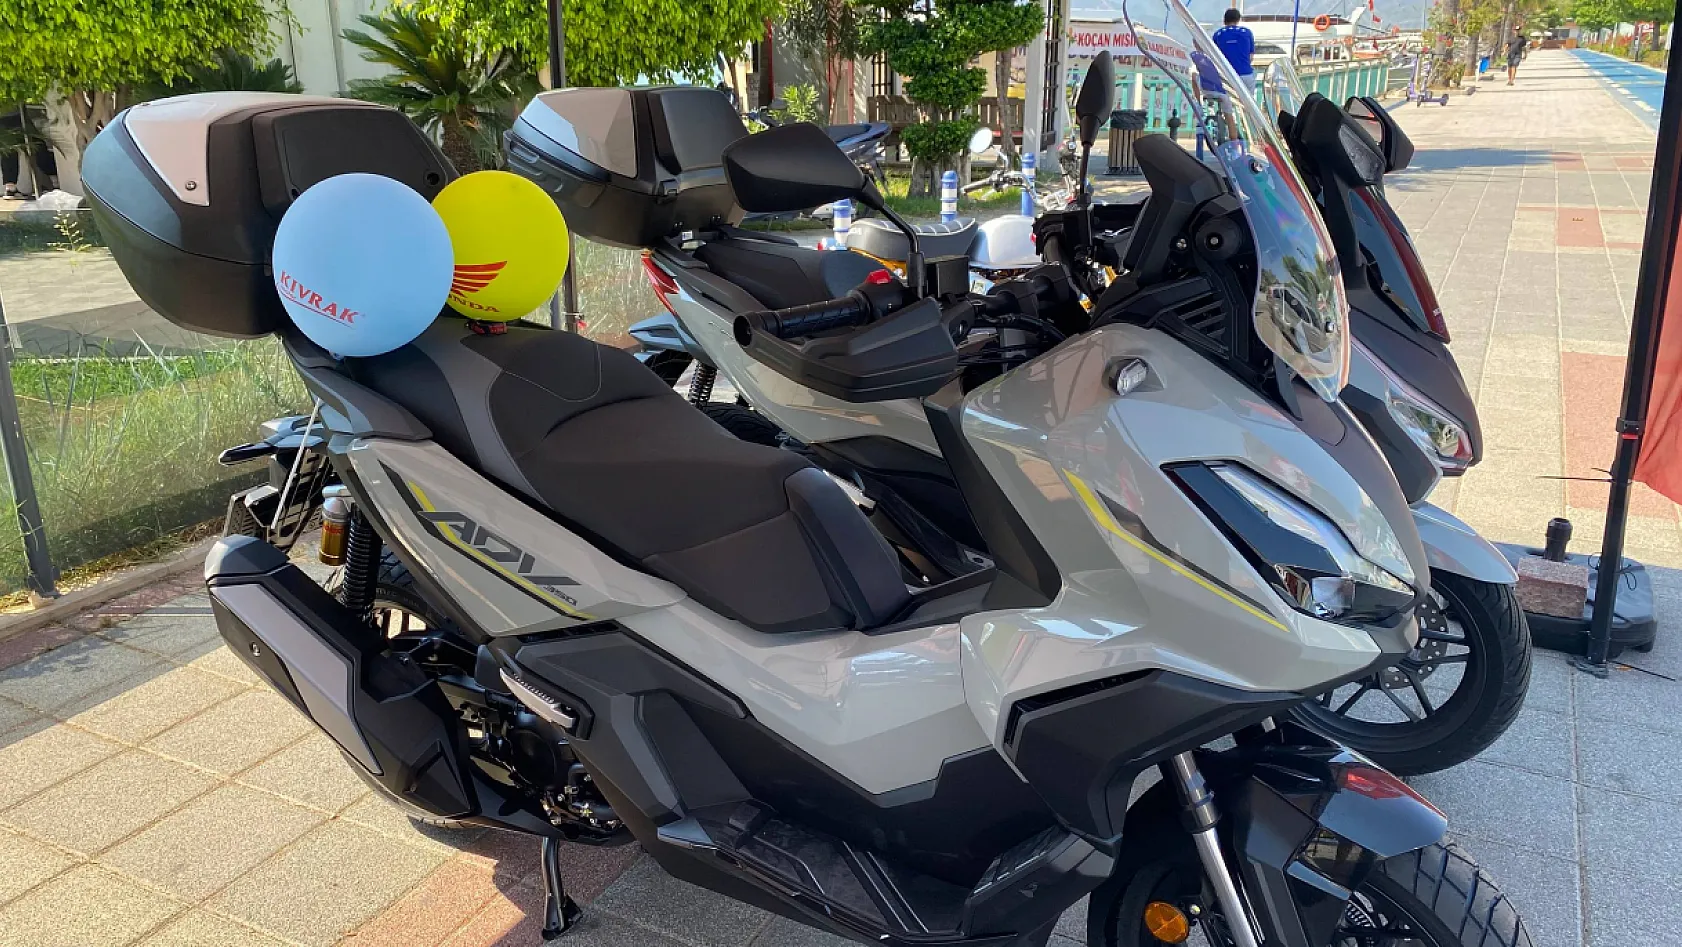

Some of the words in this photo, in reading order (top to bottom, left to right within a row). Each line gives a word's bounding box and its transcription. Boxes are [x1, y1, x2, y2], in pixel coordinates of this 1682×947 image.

[1078, 32, 1111, 48] KOÇAN
[280, 269, 358, 323] KIVRAK
[417, 511, 582, 586] ADV
